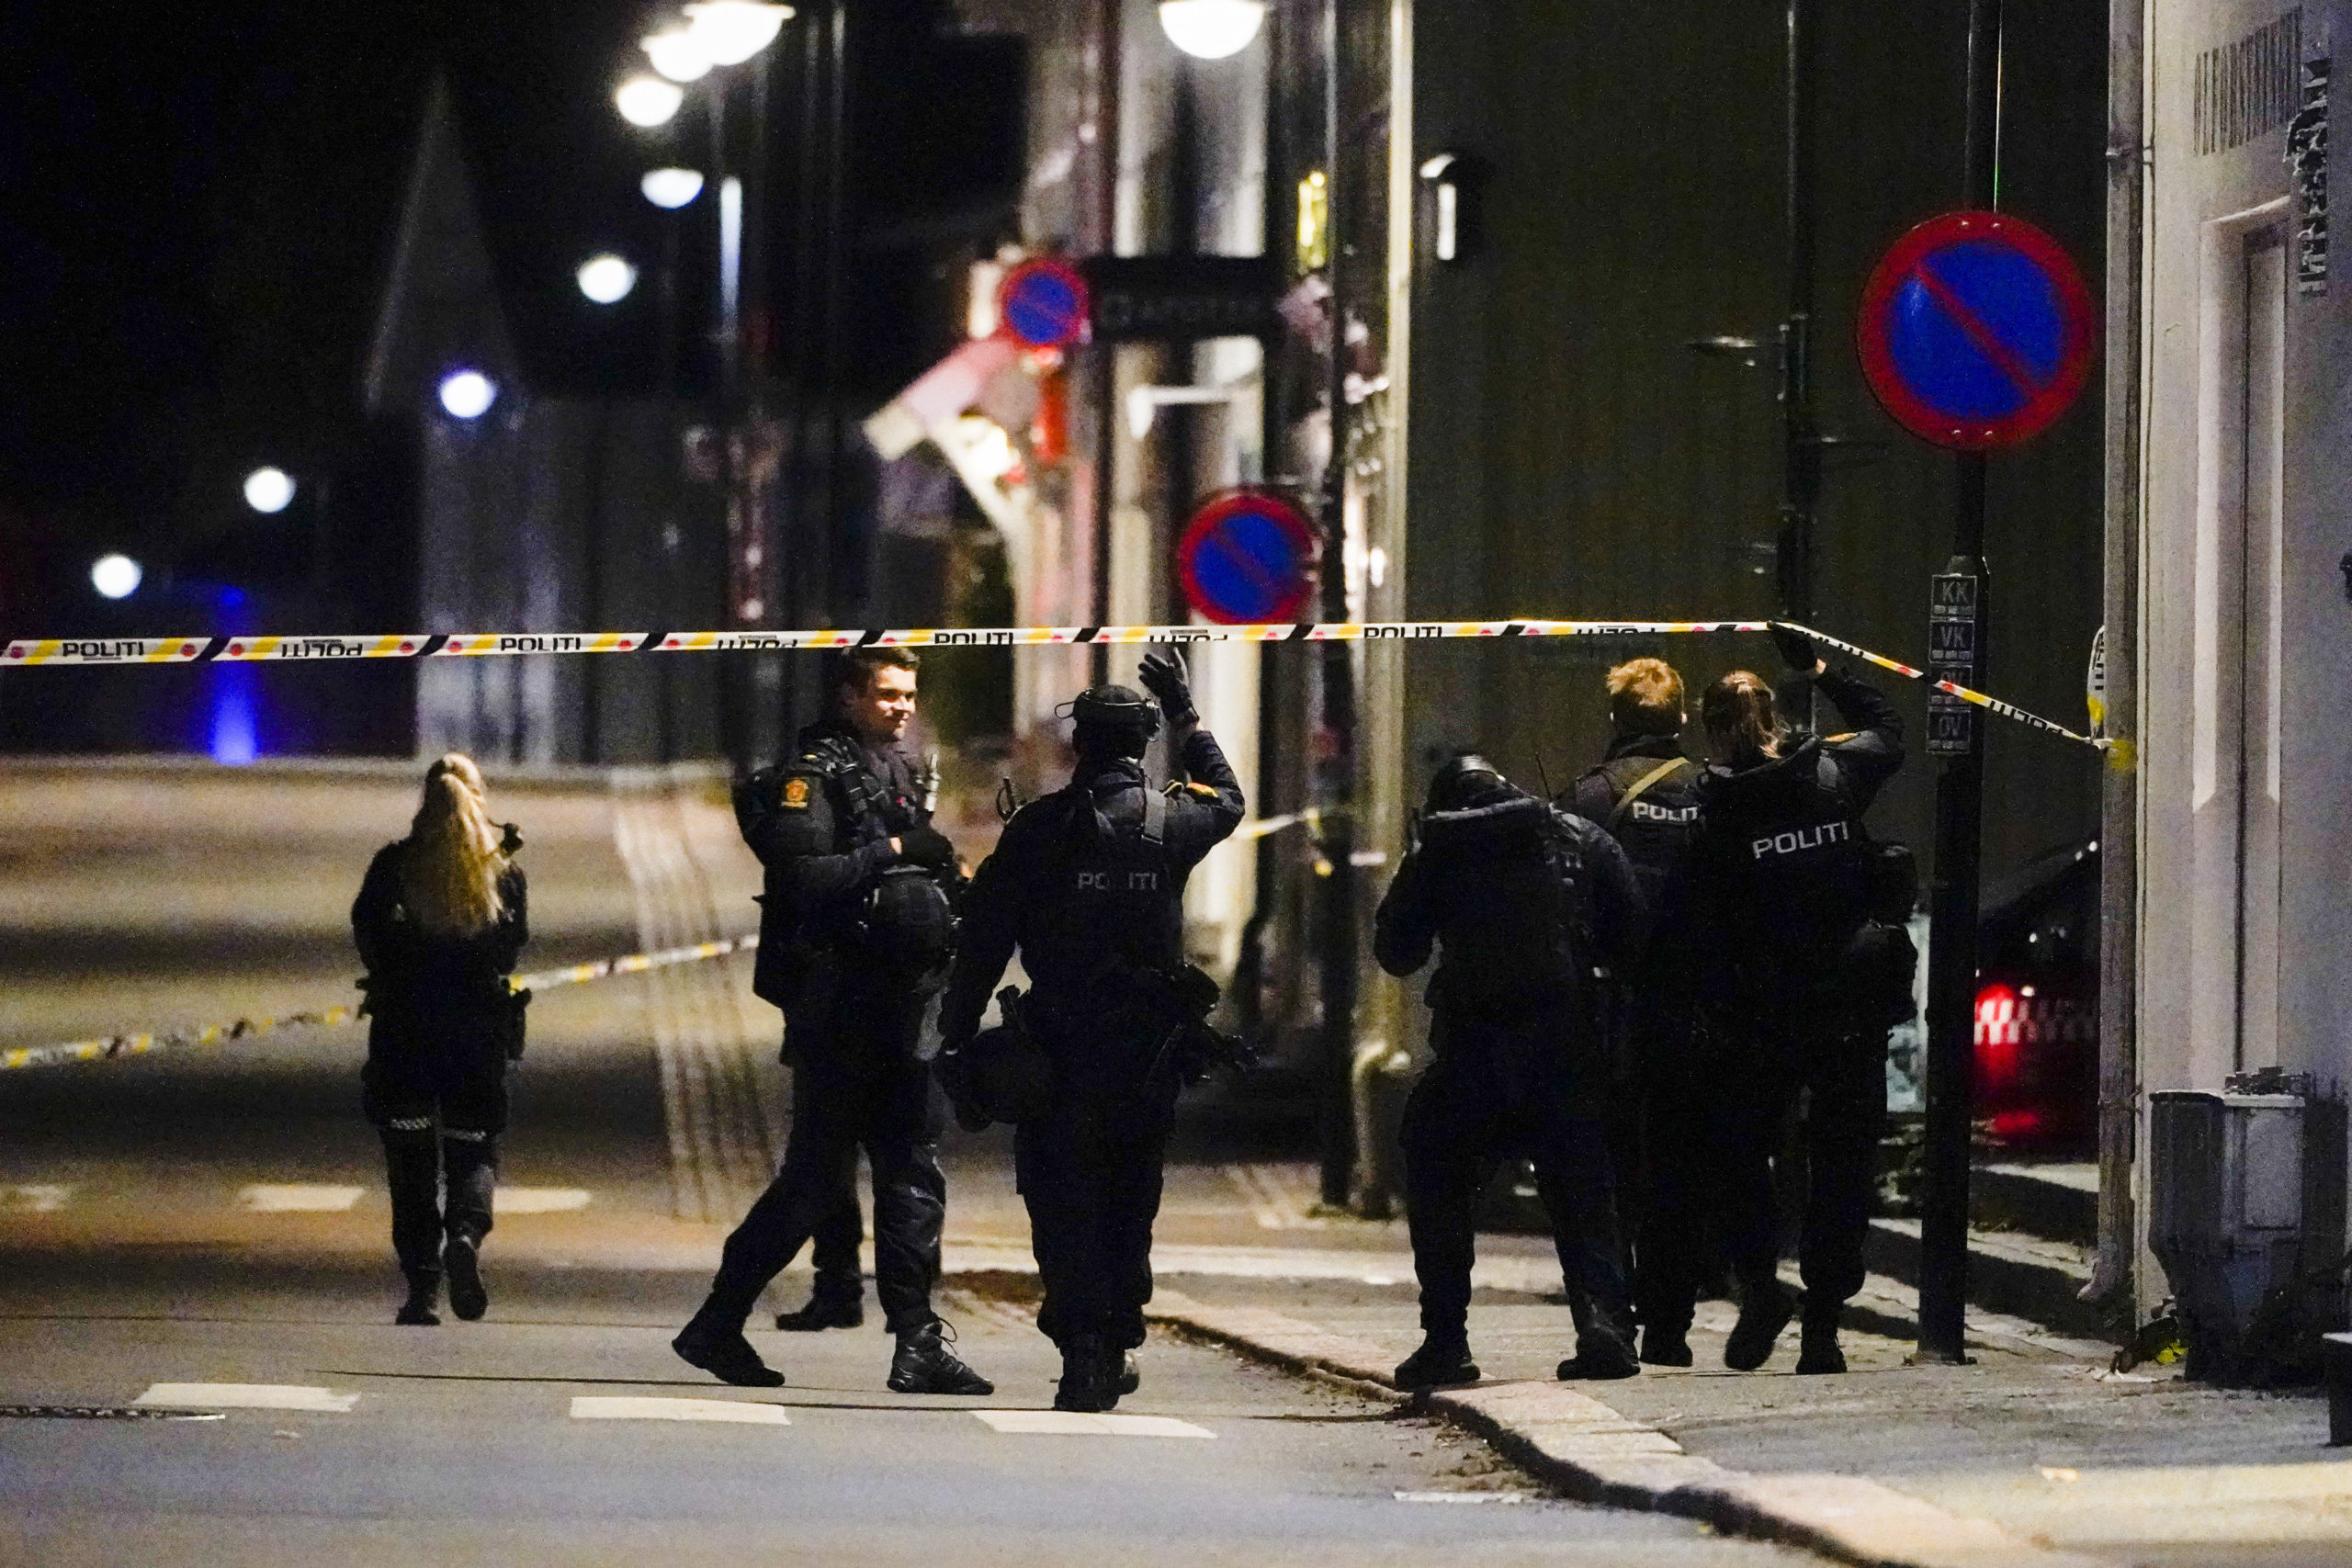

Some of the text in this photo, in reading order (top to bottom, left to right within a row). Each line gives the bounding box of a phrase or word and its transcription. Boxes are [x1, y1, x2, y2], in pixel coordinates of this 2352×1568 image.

[62, 641, 143, 657] POLITI
[281, 643, 362, 658] POLITI
[501, 637, 581, 651] POLITI
[1633, 801, 1698, 822] POLIT
[1752, 821, 1849, 859] POLITI
[1078, 873, 1157, 890] POITI
